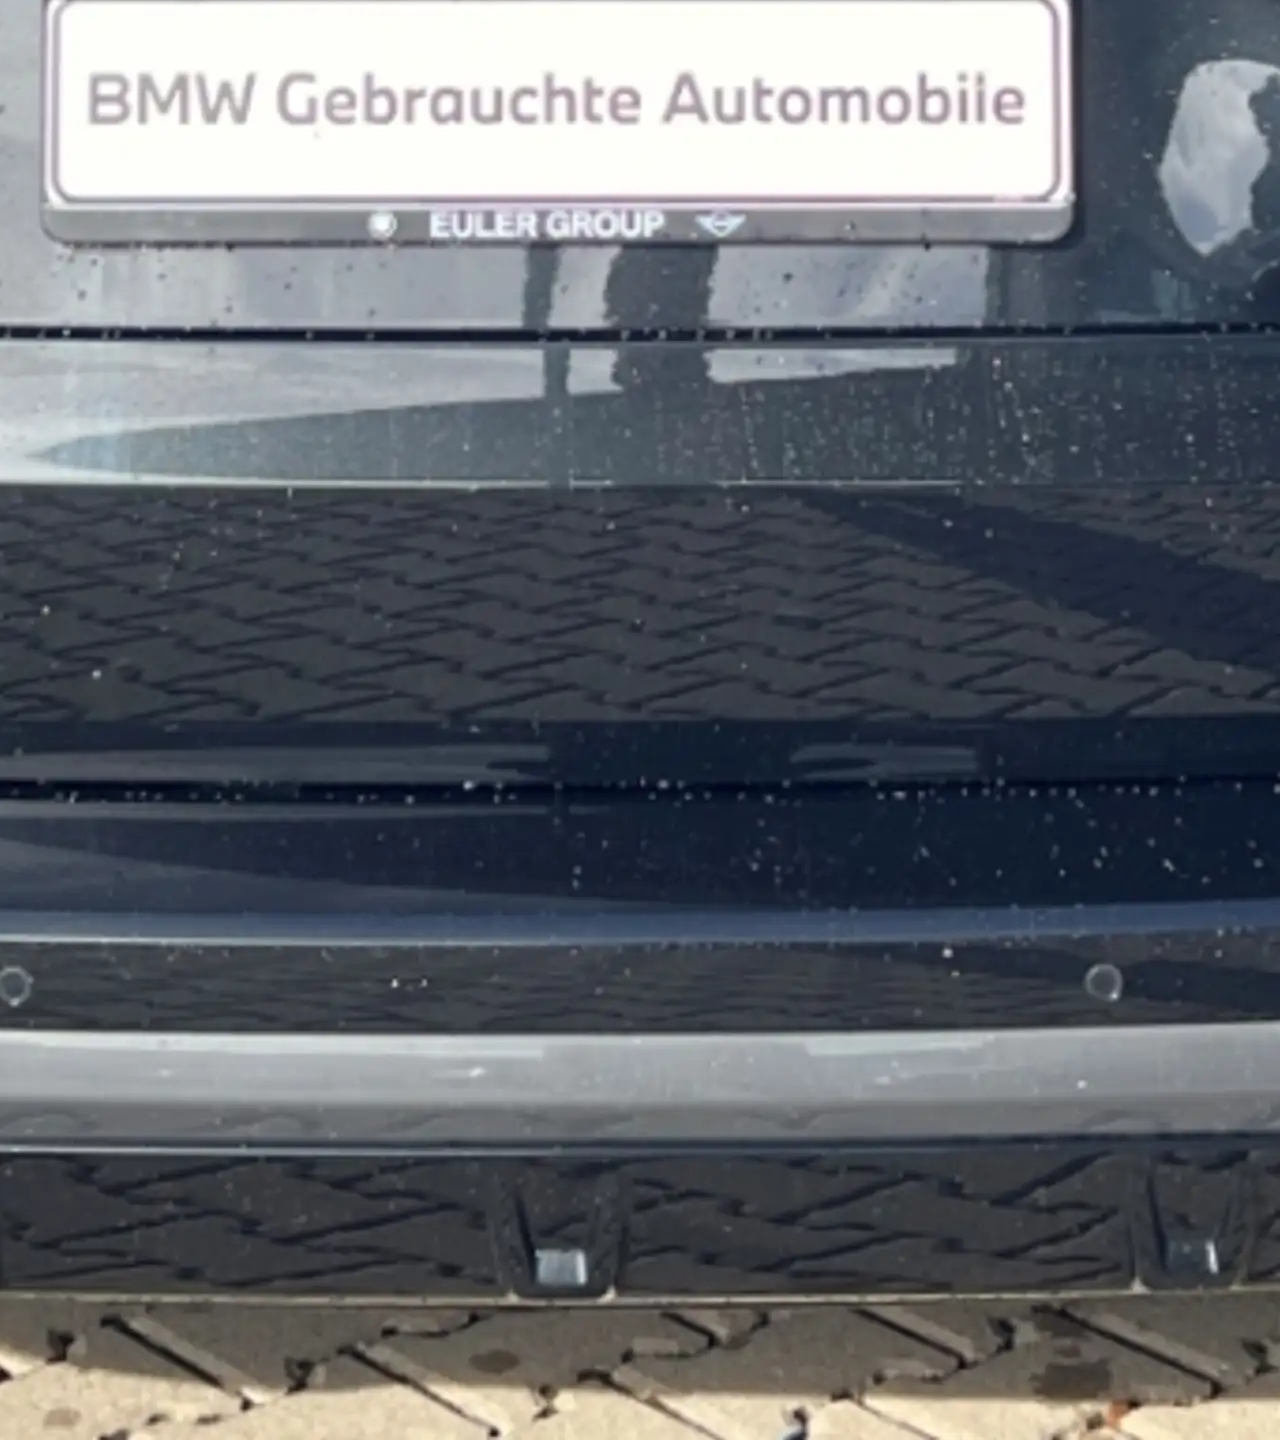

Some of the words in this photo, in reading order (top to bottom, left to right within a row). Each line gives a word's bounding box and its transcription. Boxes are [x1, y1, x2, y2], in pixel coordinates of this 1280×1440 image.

[88, 72, 256, 126] BMW
[276, 72, 642, 126] Gebrauchte
[661, 70, 1026, 126] Automobile
[429, 210, 537, 239] EULER
[545, 210, 667, 239] GROUP
